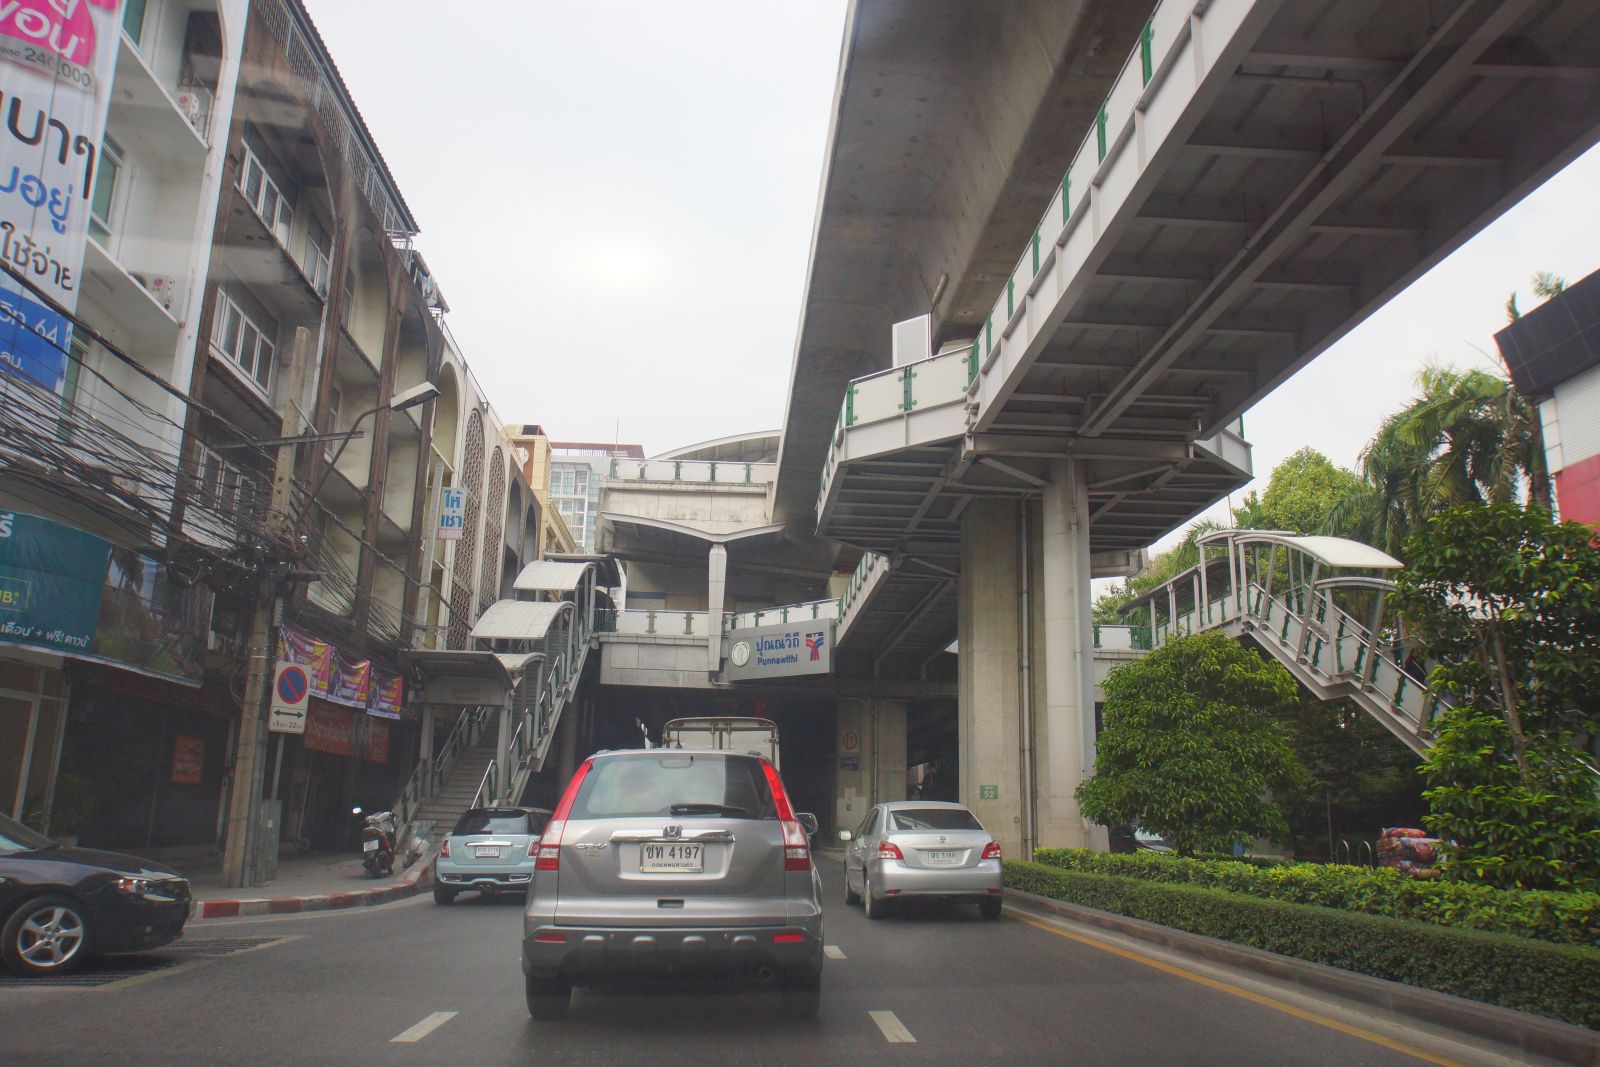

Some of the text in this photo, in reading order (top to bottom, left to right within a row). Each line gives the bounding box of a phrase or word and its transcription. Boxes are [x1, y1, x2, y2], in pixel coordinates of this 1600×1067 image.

[756, 631, 800, 656] ปุณณวิถี
[757, 654, 798, 666] Punnawithi
[669, 846, 700, 859] 4197
